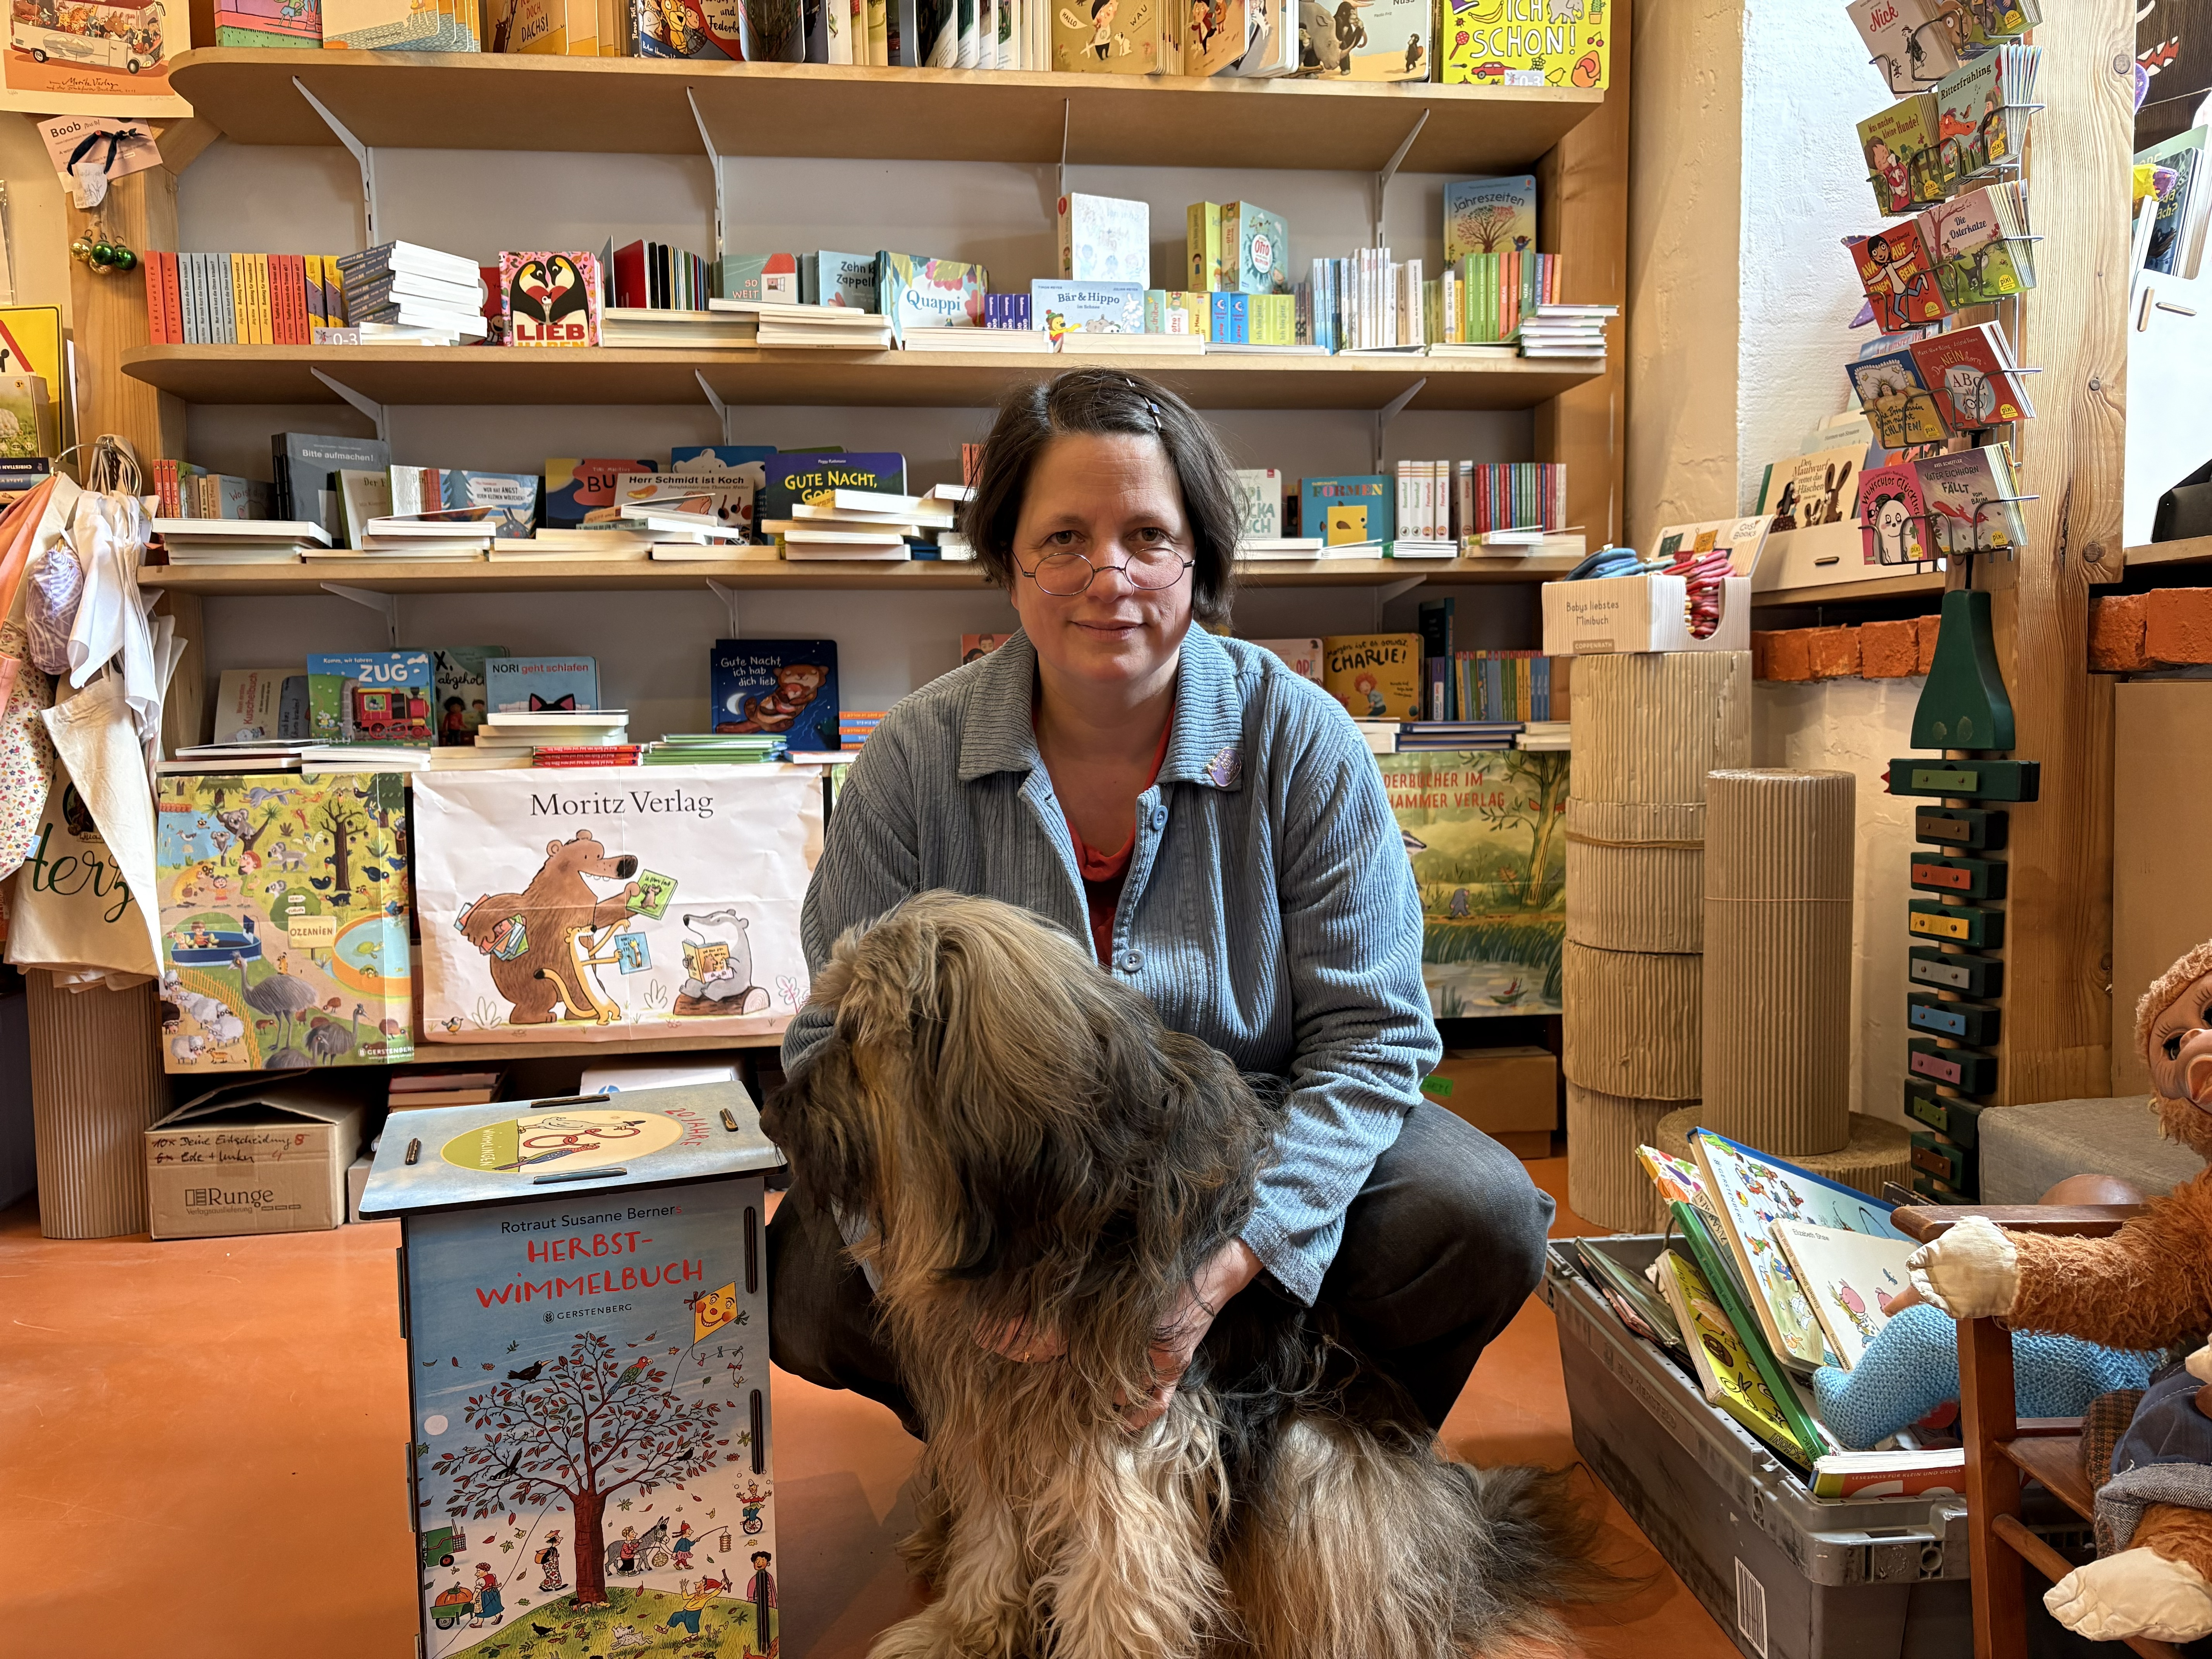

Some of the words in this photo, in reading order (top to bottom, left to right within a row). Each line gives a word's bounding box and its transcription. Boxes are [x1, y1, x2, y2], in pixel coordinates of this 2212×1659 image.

[720, 7, 736, 17] und
[1130, 5, 1148, 27] WAU
[1507, 0, 1543, 22] ICH
[1870, 1, 1899, 33] Nick
[2006, 13, 2017, 22] pixi
[1062, 11, 1079, 27] HALLO
[522, 14, 549, 43] DACHS!
[1471, 26, 1575, 59] SCHON!
[93, 78, 118, 87] Verlag
[1519, 75, 1541, 87] 0-3
[1941, 64, 1992, 100] Ritterfrühling
[50, 122, 81, 137] Boob
[1868, 121, 1878, 134] Was
[1877, 116, 1894, 129] machen
[1883, 128, 1897, 139] kleine
[1896, 113, 1920, 134] Hunde?
[1992, 142, 2002, 152] pixi
[1925, 182, 1936, 192] pixi
[1454, 193, 1525, 213] Jahreszeiten
[1954, 217, 1966, 226] Die
[1949, 220, 1987, 239] Osterkatze
[1255, 240, 1270, 255] OTTO
[1891, 243, 1907, 259] AUF
[841, 261, 866, 273] Zehn
[1862, 261, 1877, 278] AVA
[1900, 264, 1917, 281] BEIN
[745, 279, 758, 287] SO
[2000, 276, 2012, 287] pixi
[733, 290, 759, 299] WEIT
[1057, 292, 1077, 302] Bär
[1078, 292, 1087, 301] &
[1087, 292, 1120, 304] Hippo
[907, 290, 960, 316] Quappi
[1151, 302, 1159, 326] drüber
[333, 333, 358, 345] 0-3
[516, 324, 585, 341] LIEB
[1917, 345, 1938, 357] Marc-Uwe
[302, 448, 322, 459] Bitte
[325, 452, 373, 462] aufmachen!
[1792, 458, 1830, 476] Maulwurf
[1942, 459, 1963, 467] SCHEFFLER
[629, 476, 653, 484] Herr
[655, 476, 699, 484] Schmidt
[702, 476, 714, 484] ist
[718, 476, 744, 484] Koch
[785, 472, 823, 491] GUTE
[828, 470, 877, 489] NACHT,
[1813, 474, 1823, 482] das
[1925, 471, 1944, 481] VATER
[1944, 465, 1979, 479] EICHHORN
[364, 477, 378, 487] Der
[1797, 483, 1824, 494] Häschen
[1941, 481, 1969, 494] FÄLLT
[229, 491, 242, 501] Wo
[242, 488, 252, 498] ist
[502, 486, 518, 495] ANGST
[1313, 484, 1383, 497] FORMEN
[1862, 478, 1894, 505] WUNSCHLOS
[1992, 532, 2004, 541] pixi
[1911, 546, 1920, 555] pixi
[1566, 602, 1588, 612] Babys
[1589, 601, 1619, 611] liebstes
[1576, 615, 1608, 627] Minibuch
[1327, 642, 1352, 658] Morgen
[1355, 641, 1366, 649] ist
[1575, 641, 1613, 650] COPPENRATH
[720, 656, 747, 668] Gute
[750, 656, 781, 667] Nacht,
[1331, 648, 1407, 673] CHARLIE!
[359, 663, 408, 683] ZUG
[493, 665, 519, 673] NORI
[521, 664, 544, 675] geht
[546, 663, 589, 672] schlafen
[733, 667, 746, 677] ich
[749, 666, 767, 675] hab
[738, 677, 757, 687] dich
[759, 677, 776, 686] lieb
[243, 672, 258, 725] Kuschelbuch
[1465, 772, 1483, 787] IM
[530, 792, 626, 817] Moritz
[630, 789, 714, 819] Verlag
[1454, 792, 1505, 808] VERLAG
[289, 927, 333, 937] OZEANIEN
[664, 1108, 696, 1122] 20
[179, 1135, 211, 1147] Deine
[215, 1134, 292, 1150] Entscheidung
[208, 1187, 274, 1208] Runge
[1717, 1167, 1745, 1224] GERSTENBERG
[186, 1206, 253, 1216] Verlagsauslieferung
[501, 1218, 557, 1235] Rotraut
[561, 1212, 622, 1227] Susanne
[627, 1204, 682, 1220] Berners
[1791, 1228, 1813, 1239] Elizabeth
[1814, 1233, 1830, 1242] Shaw
[527, 1230, 654, 1264] HERBST-
[1798, 1272, 1809, 1286] Shaw
[1805, 1286, 1820, 1309] Elizabeth
[556, 1304, 633, 1320] GERSTENBERG
[1828, 1333, 1852, 1370] KinderbuchVerlag
[1769, 1432, 1805, 1461] SCHON!
